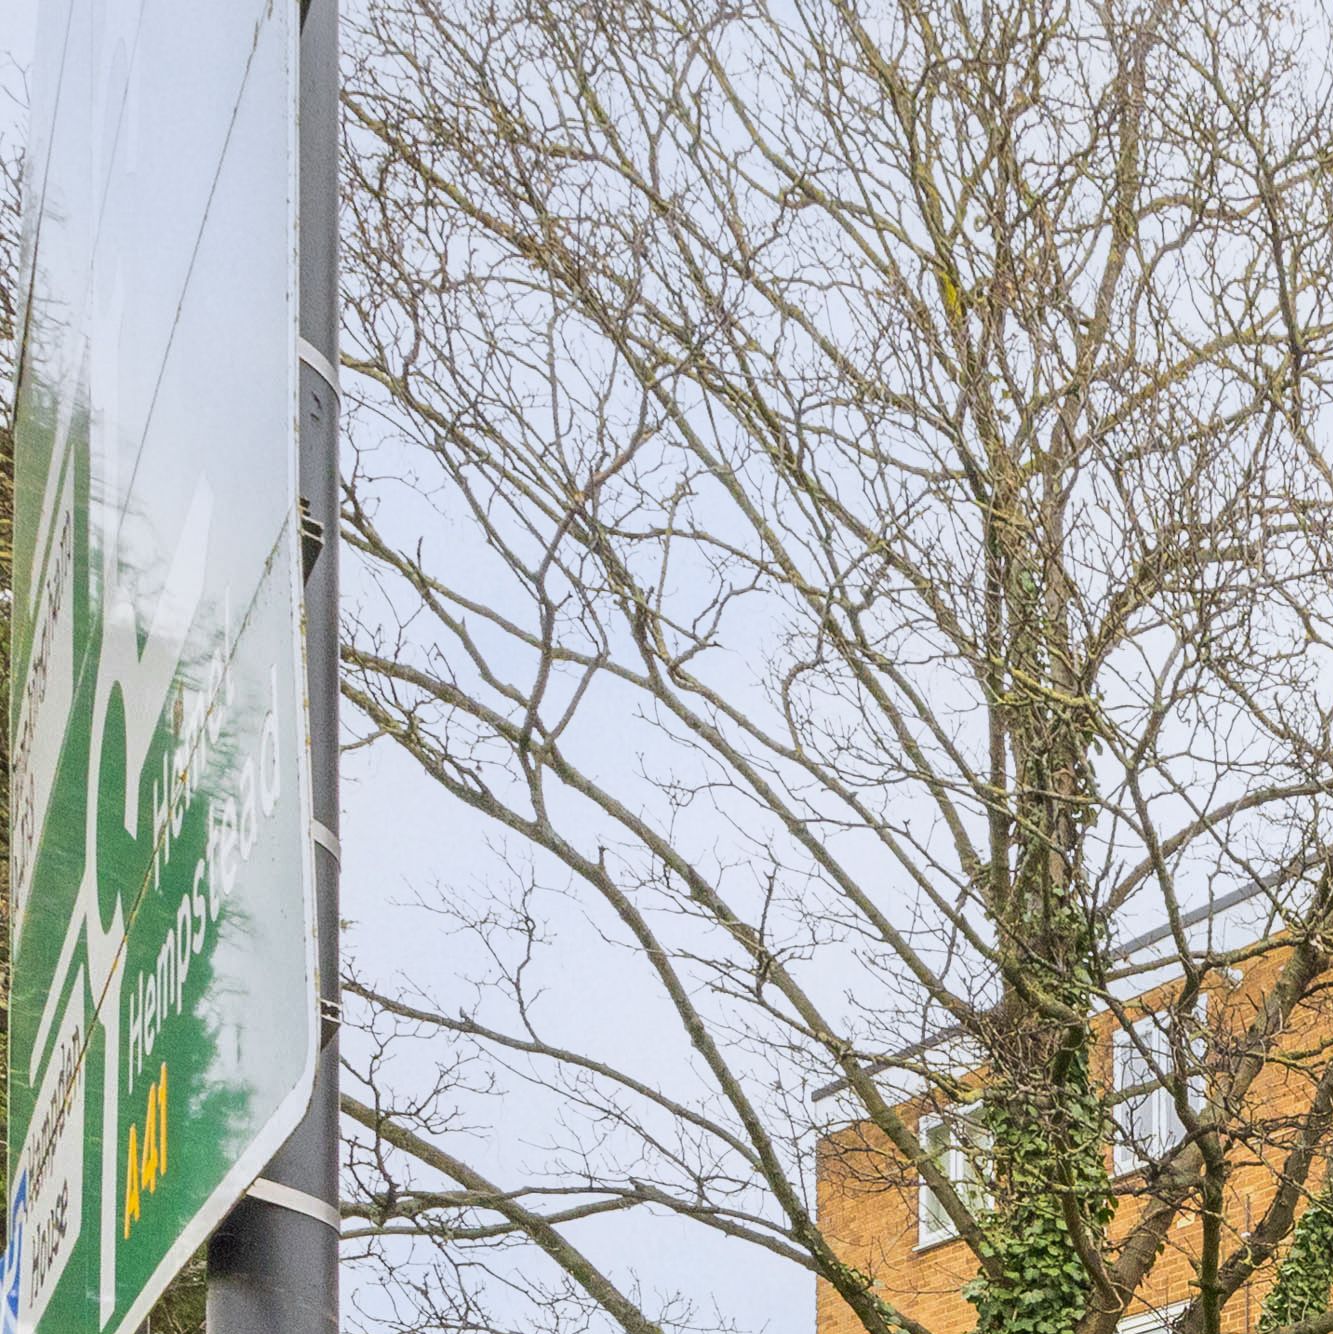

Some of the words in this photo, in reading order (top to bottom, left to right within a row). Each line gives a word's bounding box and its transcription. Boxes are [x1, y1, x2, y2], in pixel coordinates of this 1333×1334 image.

[127, 664, 281, 1096] Hempstead
[124, 1062, 168, 1241] A41
[29, 1178, 69, 1309] House
